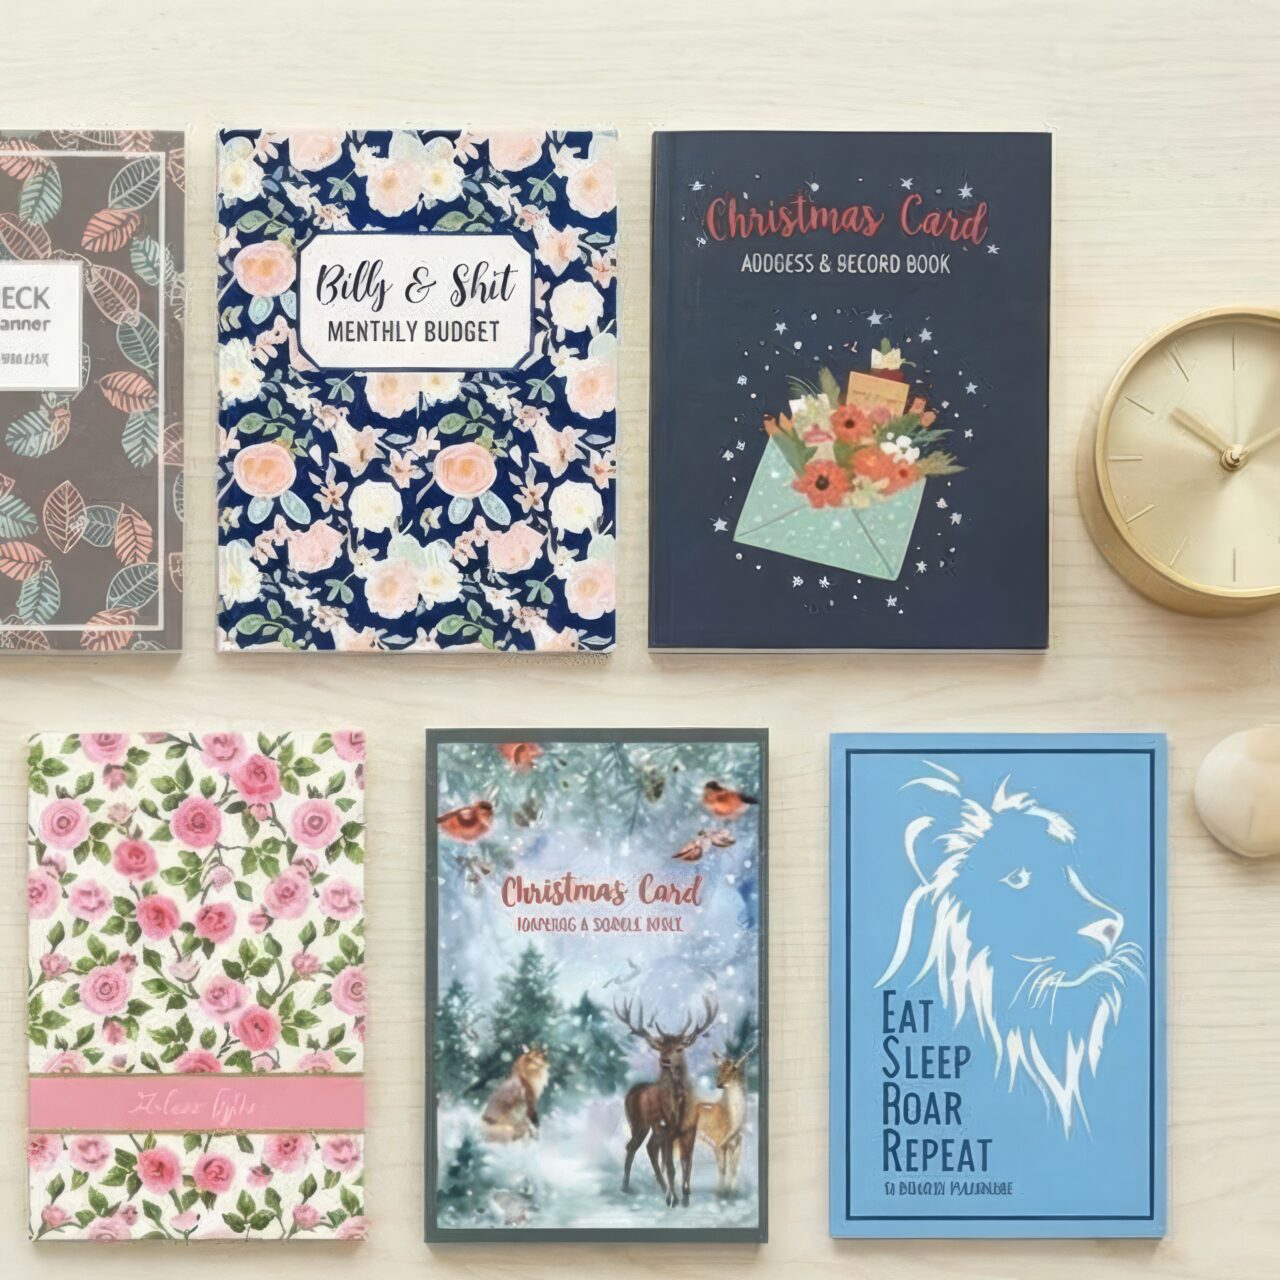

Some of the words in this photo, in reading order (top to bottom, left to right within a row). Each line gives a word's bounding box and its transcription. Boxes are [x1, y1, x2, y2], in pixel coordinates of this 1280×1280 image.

[706, 191, 886, 242] Christmas
[900, 193, 989, 245] Card
[404, 267, 437, 304] &
[450, 261, 519, 308] Shit
[819, 253, 831, 273] &
[906, 254, 951, 274] BOOK
[424, 320, 500, 343] BUDGET
[501, 871, 628, 908] Christmas
[638, 873, 704, 907] Card
[882, 989, 934, 1034] EAT
[881, 1035, 971, 1079] SLEEP
[882, 1081, 962, 1126] ROAR
[882, 1127, 993, 1173] REPEAT
